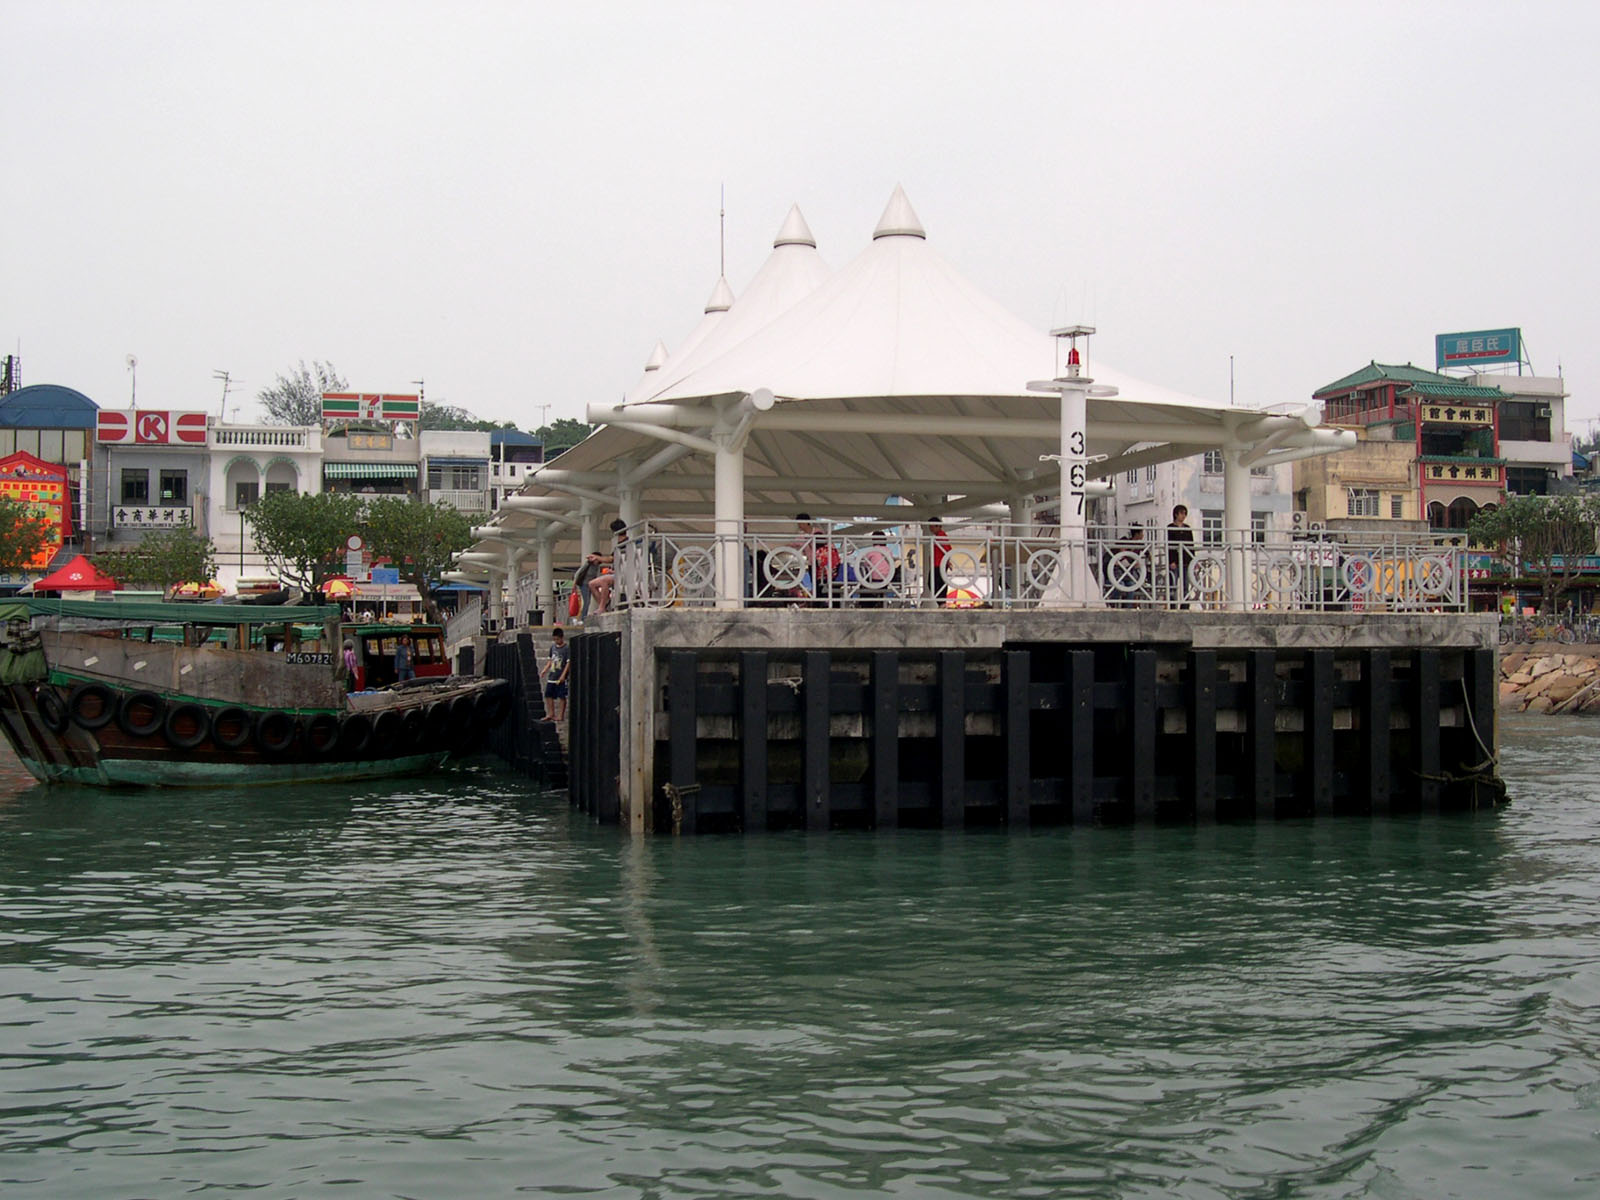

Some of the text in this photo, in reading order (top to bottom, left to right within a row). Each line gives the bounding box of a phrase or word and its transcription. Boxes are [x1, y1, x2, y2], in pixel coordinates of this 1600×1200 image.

[1456, 337, 1499, 353] 屈臣氏
[143, 416, 164, 440] K
